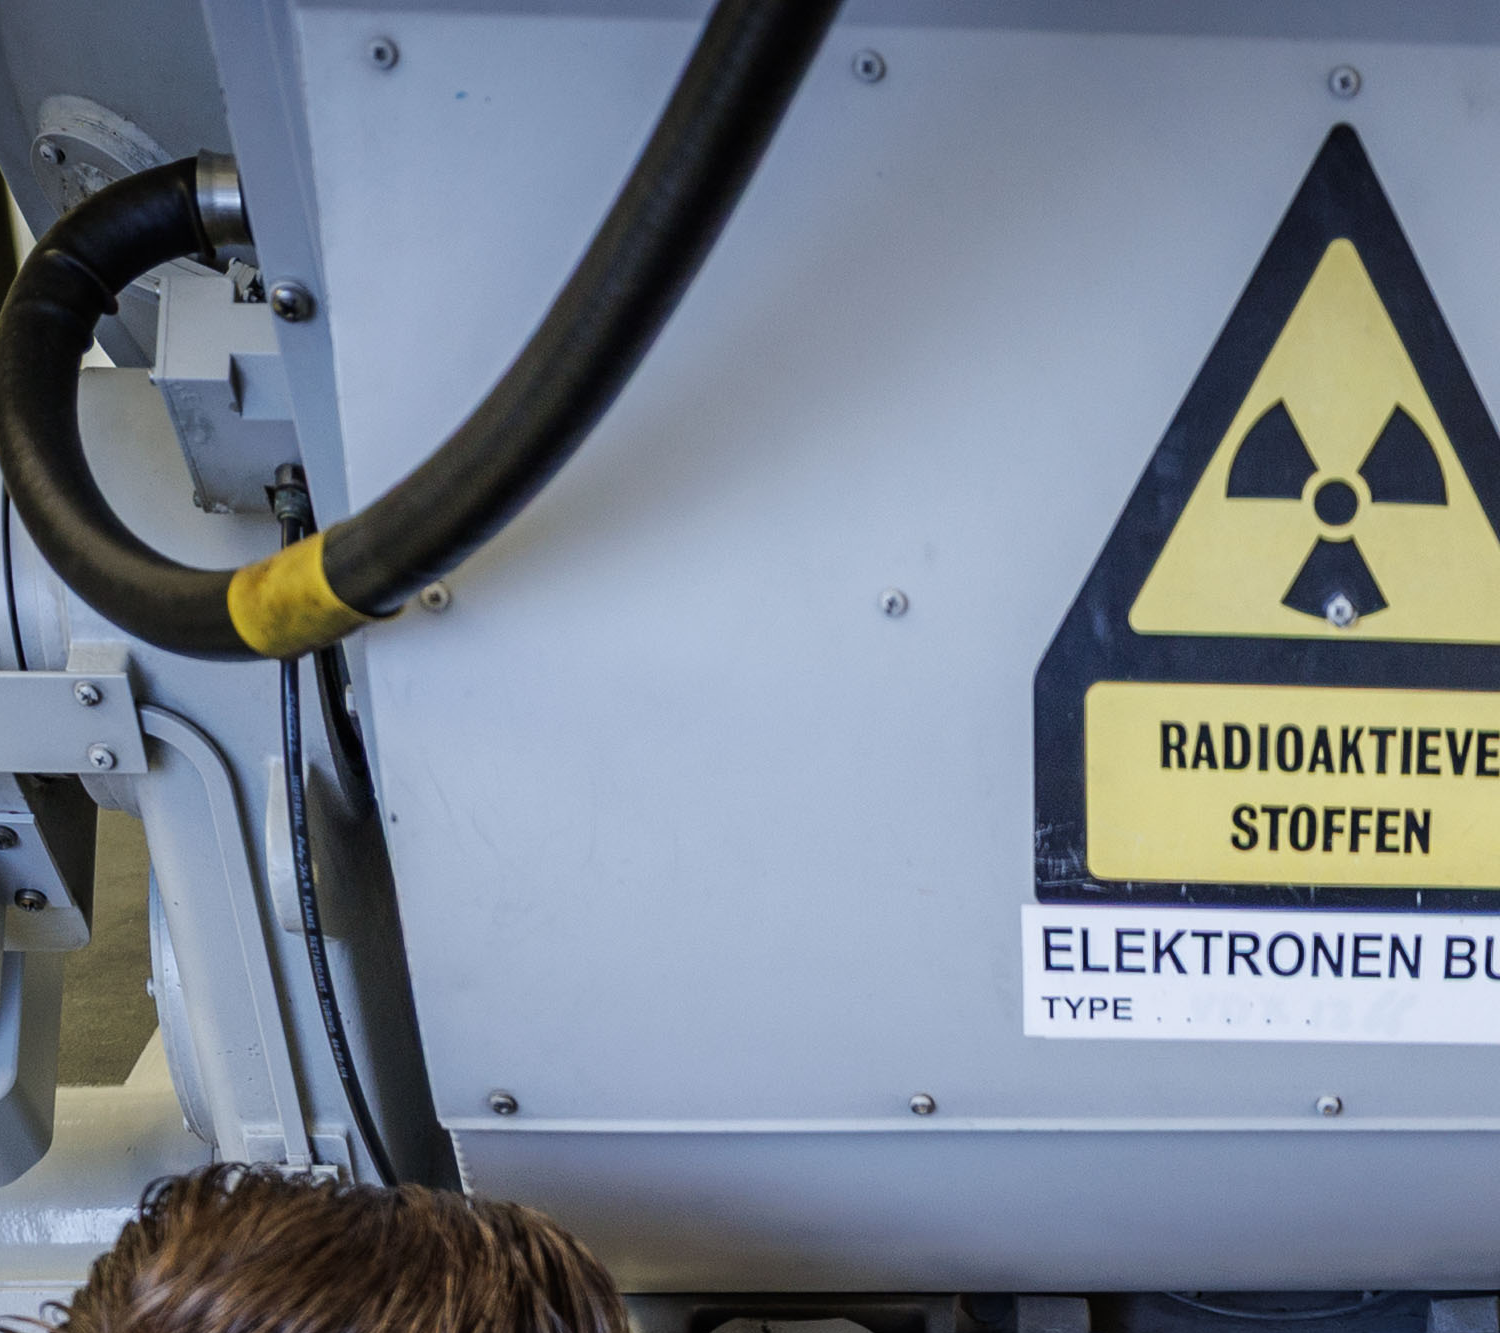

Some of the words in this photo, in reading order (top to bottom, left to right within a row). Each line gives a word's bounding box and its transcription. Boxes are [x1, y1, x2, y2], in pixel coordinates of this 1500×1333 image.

[1229, 803, 1432, 855] STOFFEN
[303, 895, 316, 930] FLAME
[308, 935, 328, 993] RETARDANT
[1042, 926, 1422, 980] ELEKTRONEN
[320, 998, 337, 1033] TUBING
[1042, 996, 1133, 1022] TYPE
